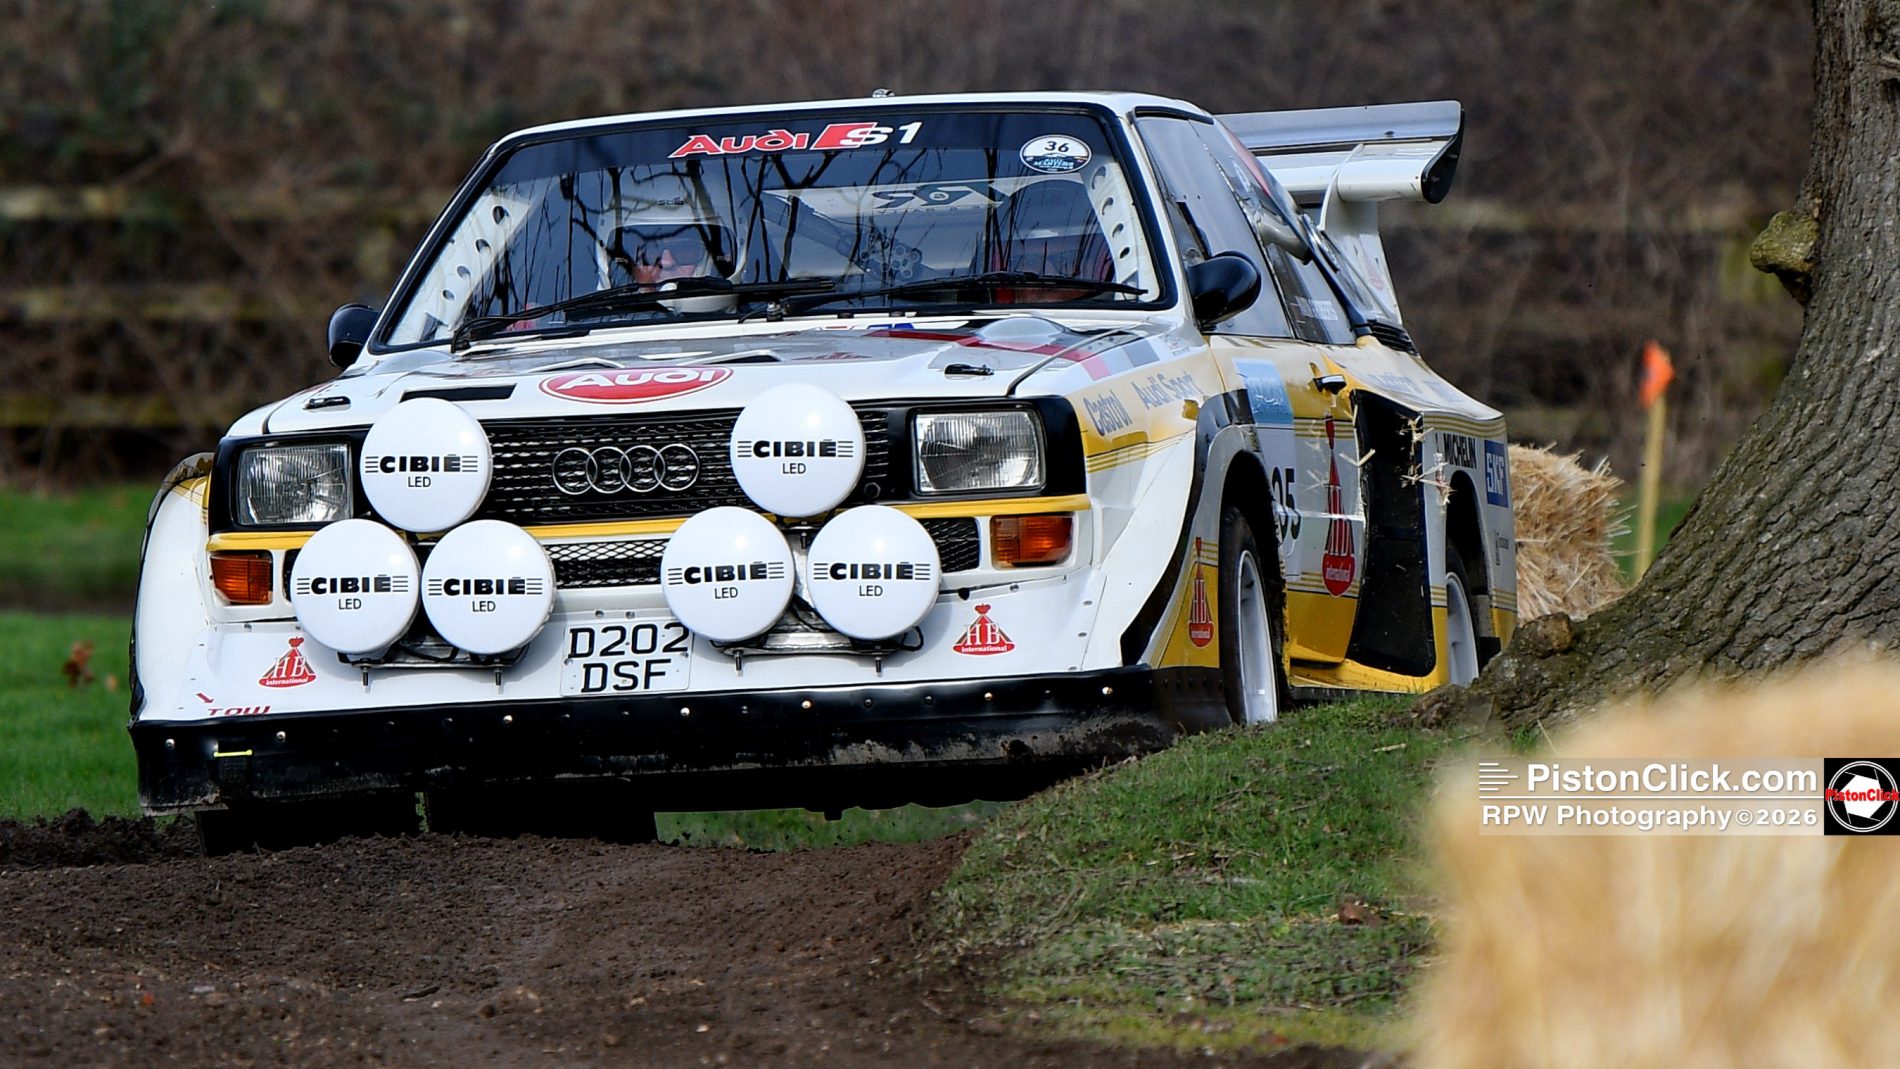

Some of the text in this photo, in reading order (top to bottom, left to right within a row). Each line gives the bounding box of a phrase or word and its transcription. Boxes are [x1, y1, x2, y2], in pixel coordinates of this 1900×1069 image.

[1044, 140, 1070, 153] 36
[1130, 374, 1174, 411] Audi
[1157, 368, 1205, 402] Sport
[1083, 388, 1133, 437] Castrol
[1443, 433, 1477, 469] MICHELIN
[783, 463, 806, 475] LED
[1486, 452, 1505, 495] SKF
[408, 476, 431, 488] LED
[714, 586, 739, 599] LED
[859, 585, 884, 597] LED
[339, 599, 362, 611] LED
[472, 600, 496, 613] LED
[569, 622, 690, 660] D202
[964, 623, 1001, 646] HB
[961, 645, 1008, 653] international
[272, 656, 307, 679] HB
[265, 677, 309, 686] international
[581, 658, 672, 693] DSF
[208, 705, 271, 717] TOW
